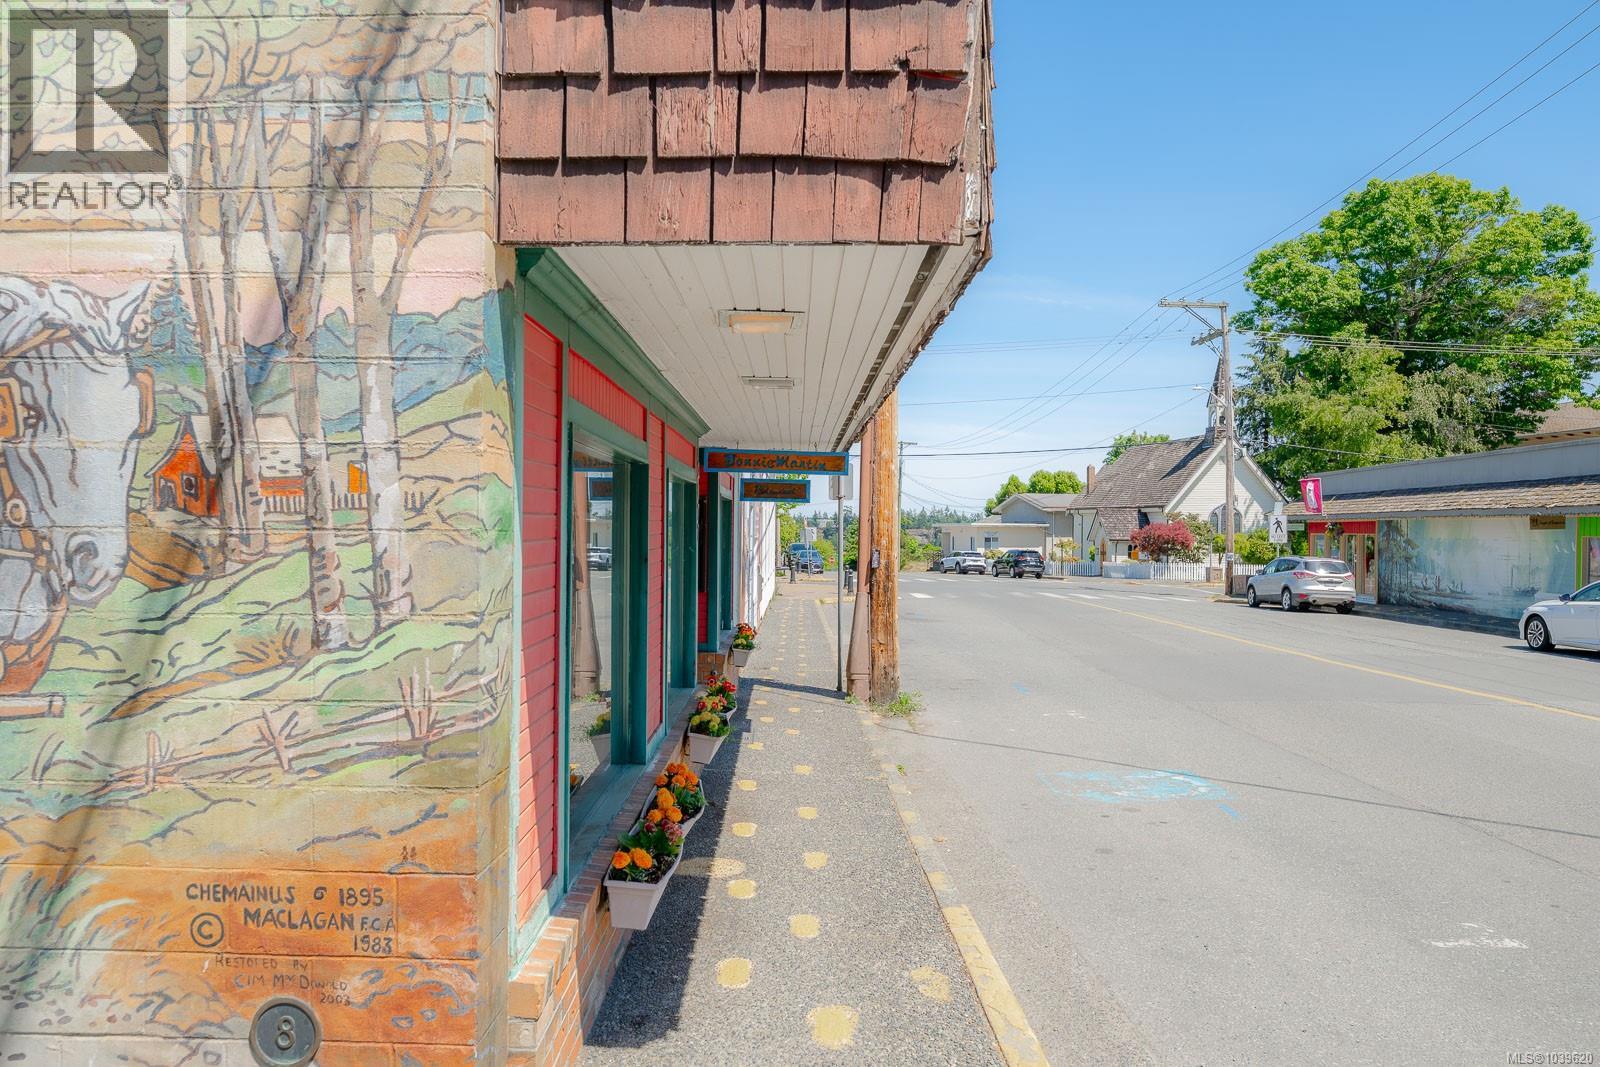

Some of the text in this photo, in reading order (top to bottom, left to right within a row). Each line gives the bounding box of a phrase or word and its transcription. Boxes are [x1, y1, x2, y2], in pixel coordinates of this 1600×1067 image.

[186, 883, 295, 904] CHEMAINUS
[339, 887, 384, 906] 1895
[243, 907, 354, 931] MACLAGAN
[353, 934, 393, 955] 1983
[275, 1016, 296, 1050] 8
